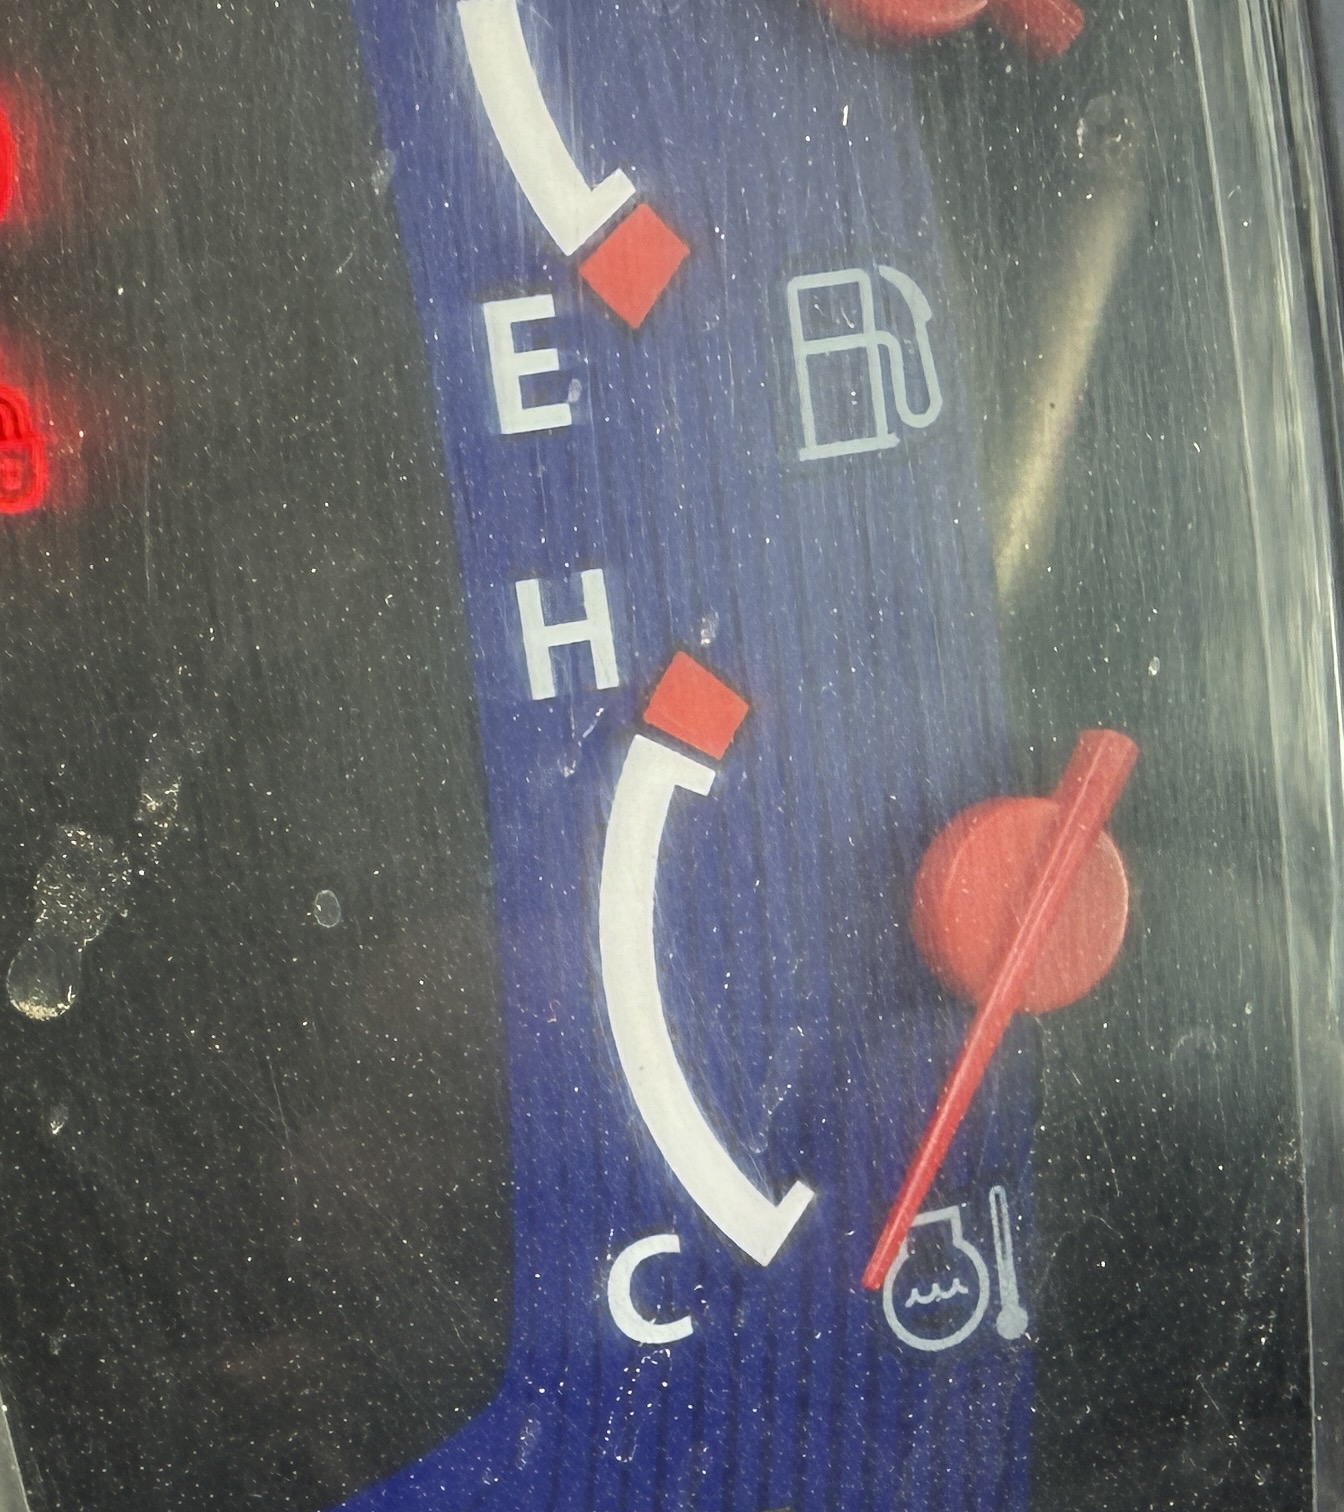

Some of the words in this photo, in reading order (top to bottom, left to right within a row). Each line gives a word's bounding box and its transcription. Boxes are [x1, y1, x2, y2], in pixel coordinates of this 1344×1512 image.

[482, 293, 572, 435] E
[515, 568, 620, 701] H
[607, 1233, 695, 1345] C
